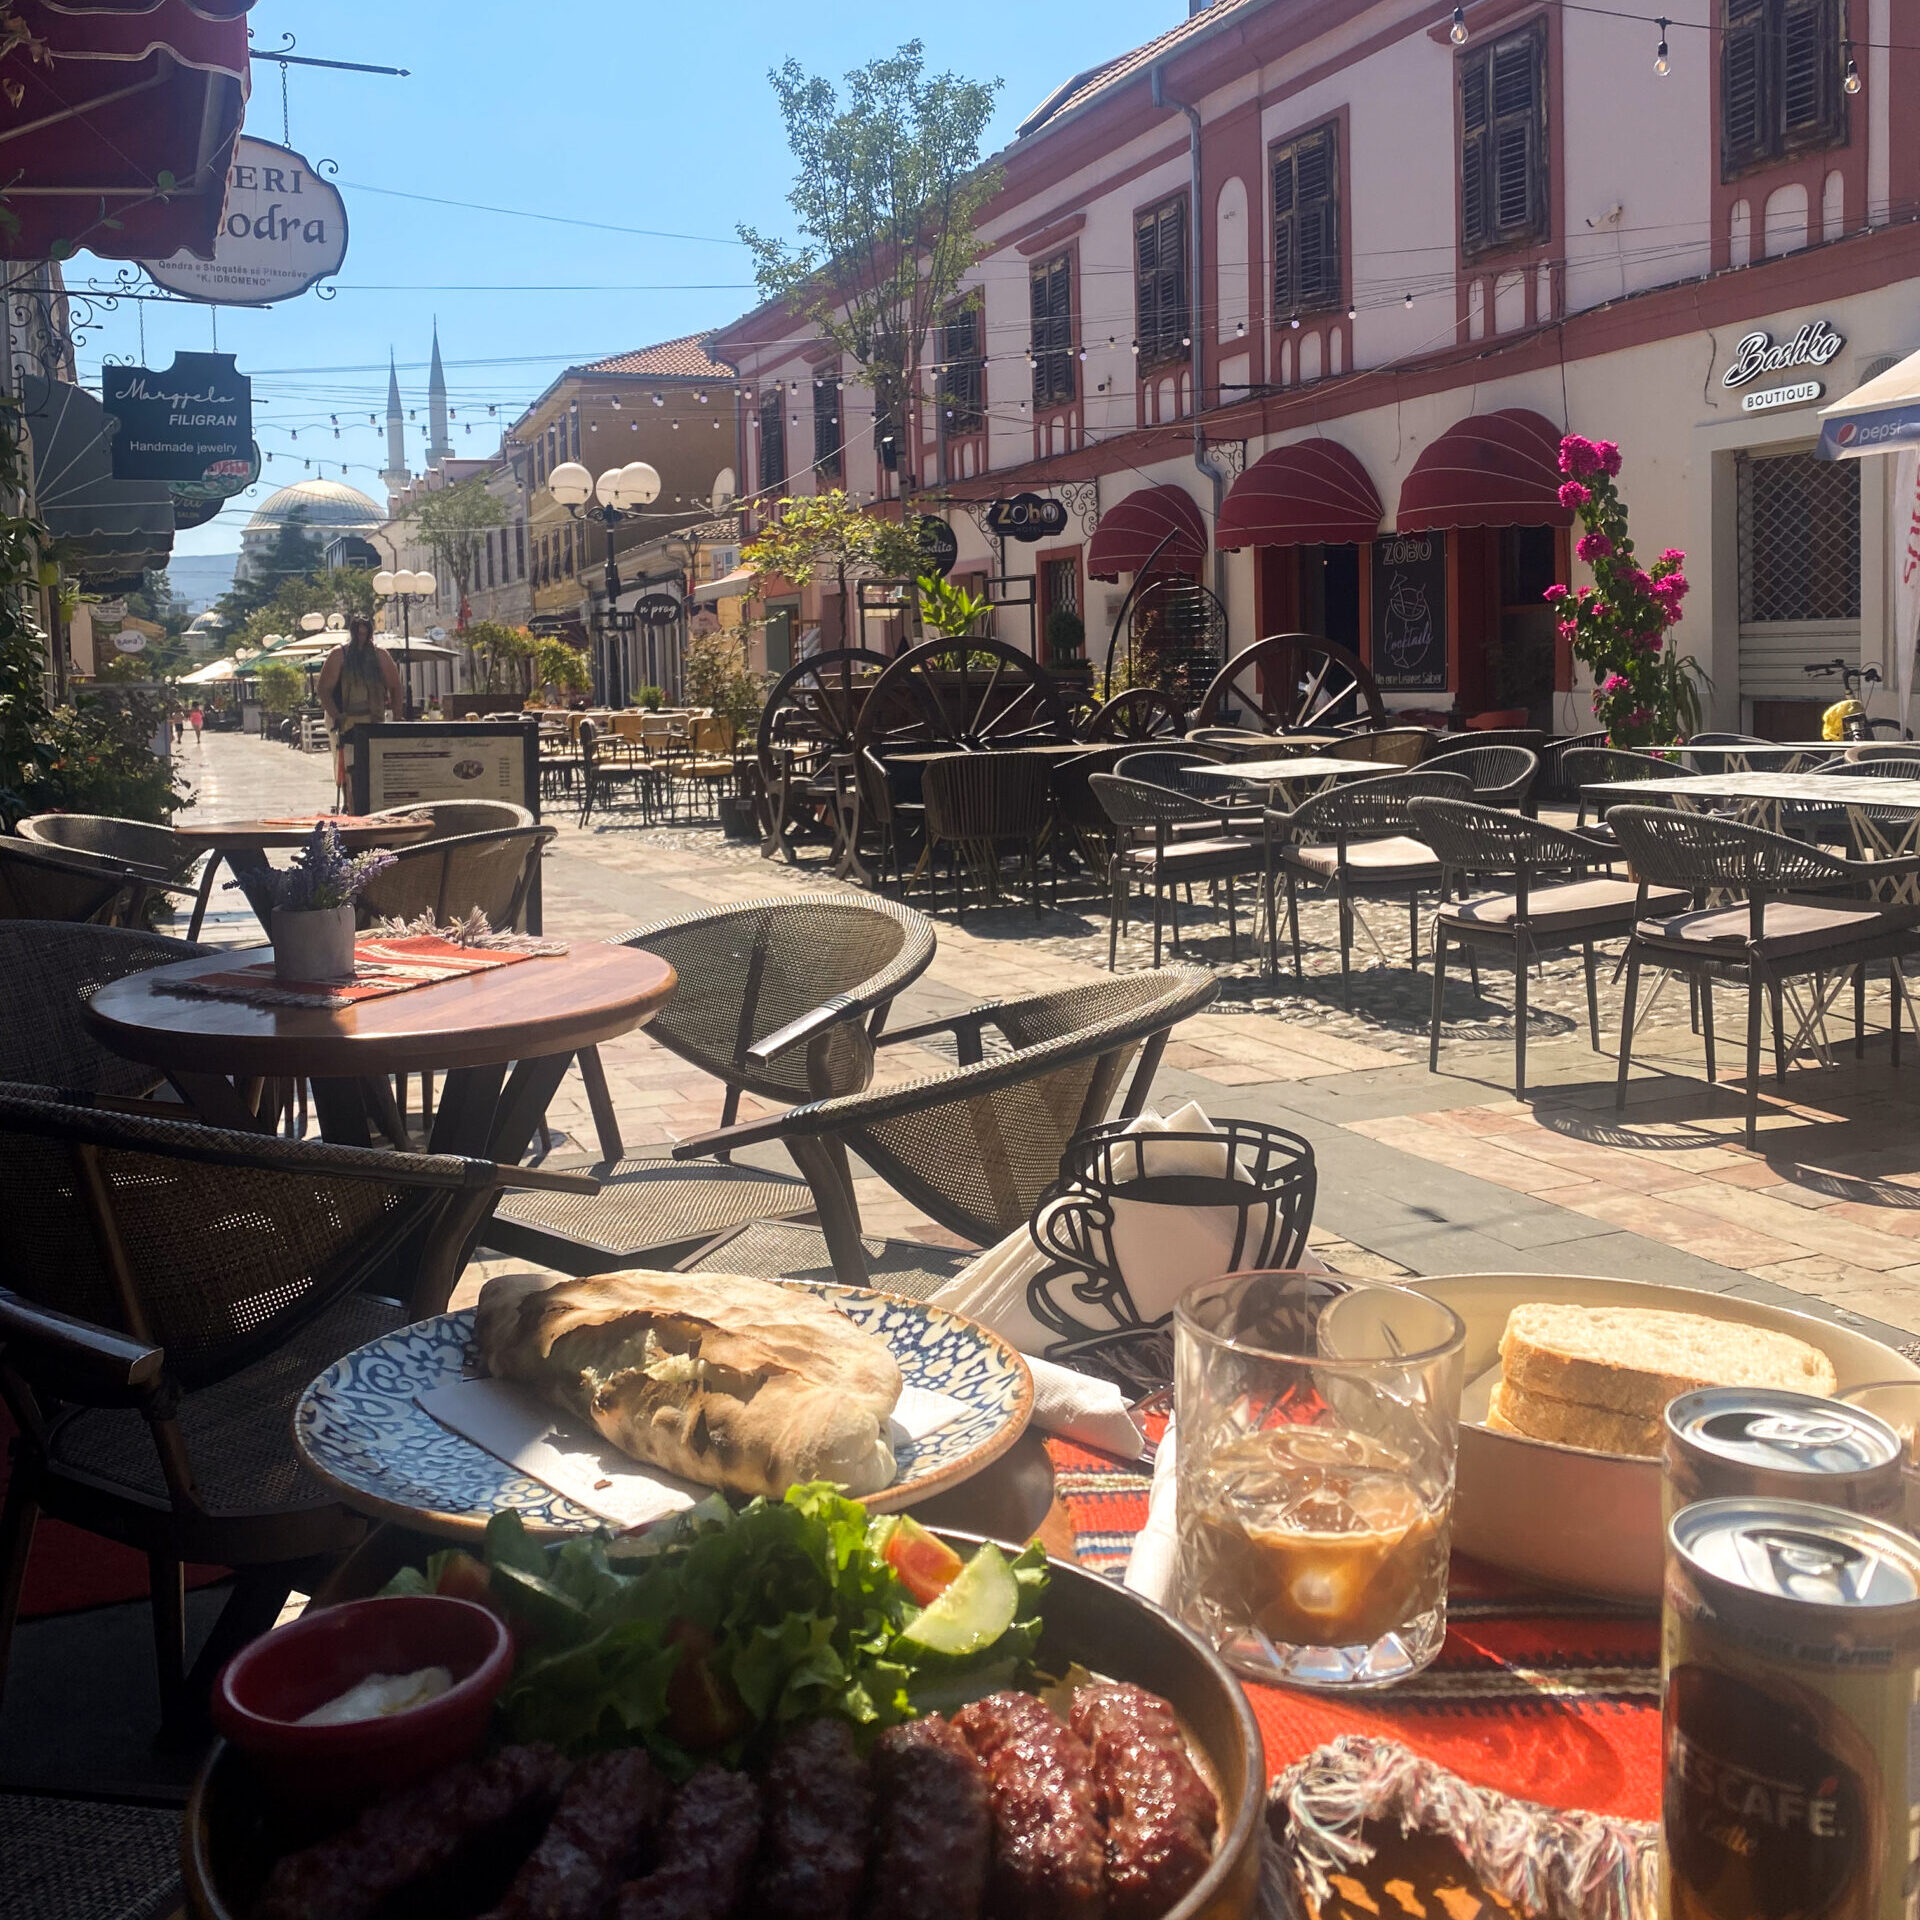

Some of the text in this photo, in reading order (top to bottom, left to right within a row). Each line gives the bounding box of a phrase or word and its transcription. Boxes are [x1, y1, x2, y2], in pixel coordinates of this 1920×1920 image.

[221, 204, 328, 244] odra
[158, 260, 193, 270] Qendra
[1747, 385, 1814, 408] BOUTIQUE
[169, 414, 237, 426] FILIGRAN
[1859, 419, 1902, 443] pepsi
[130, 440, 237, 456] Handmade jewelry
[1382, 539, 1432, 566] ZOBO
[1385, 621, 1433, 654] Cocktails
